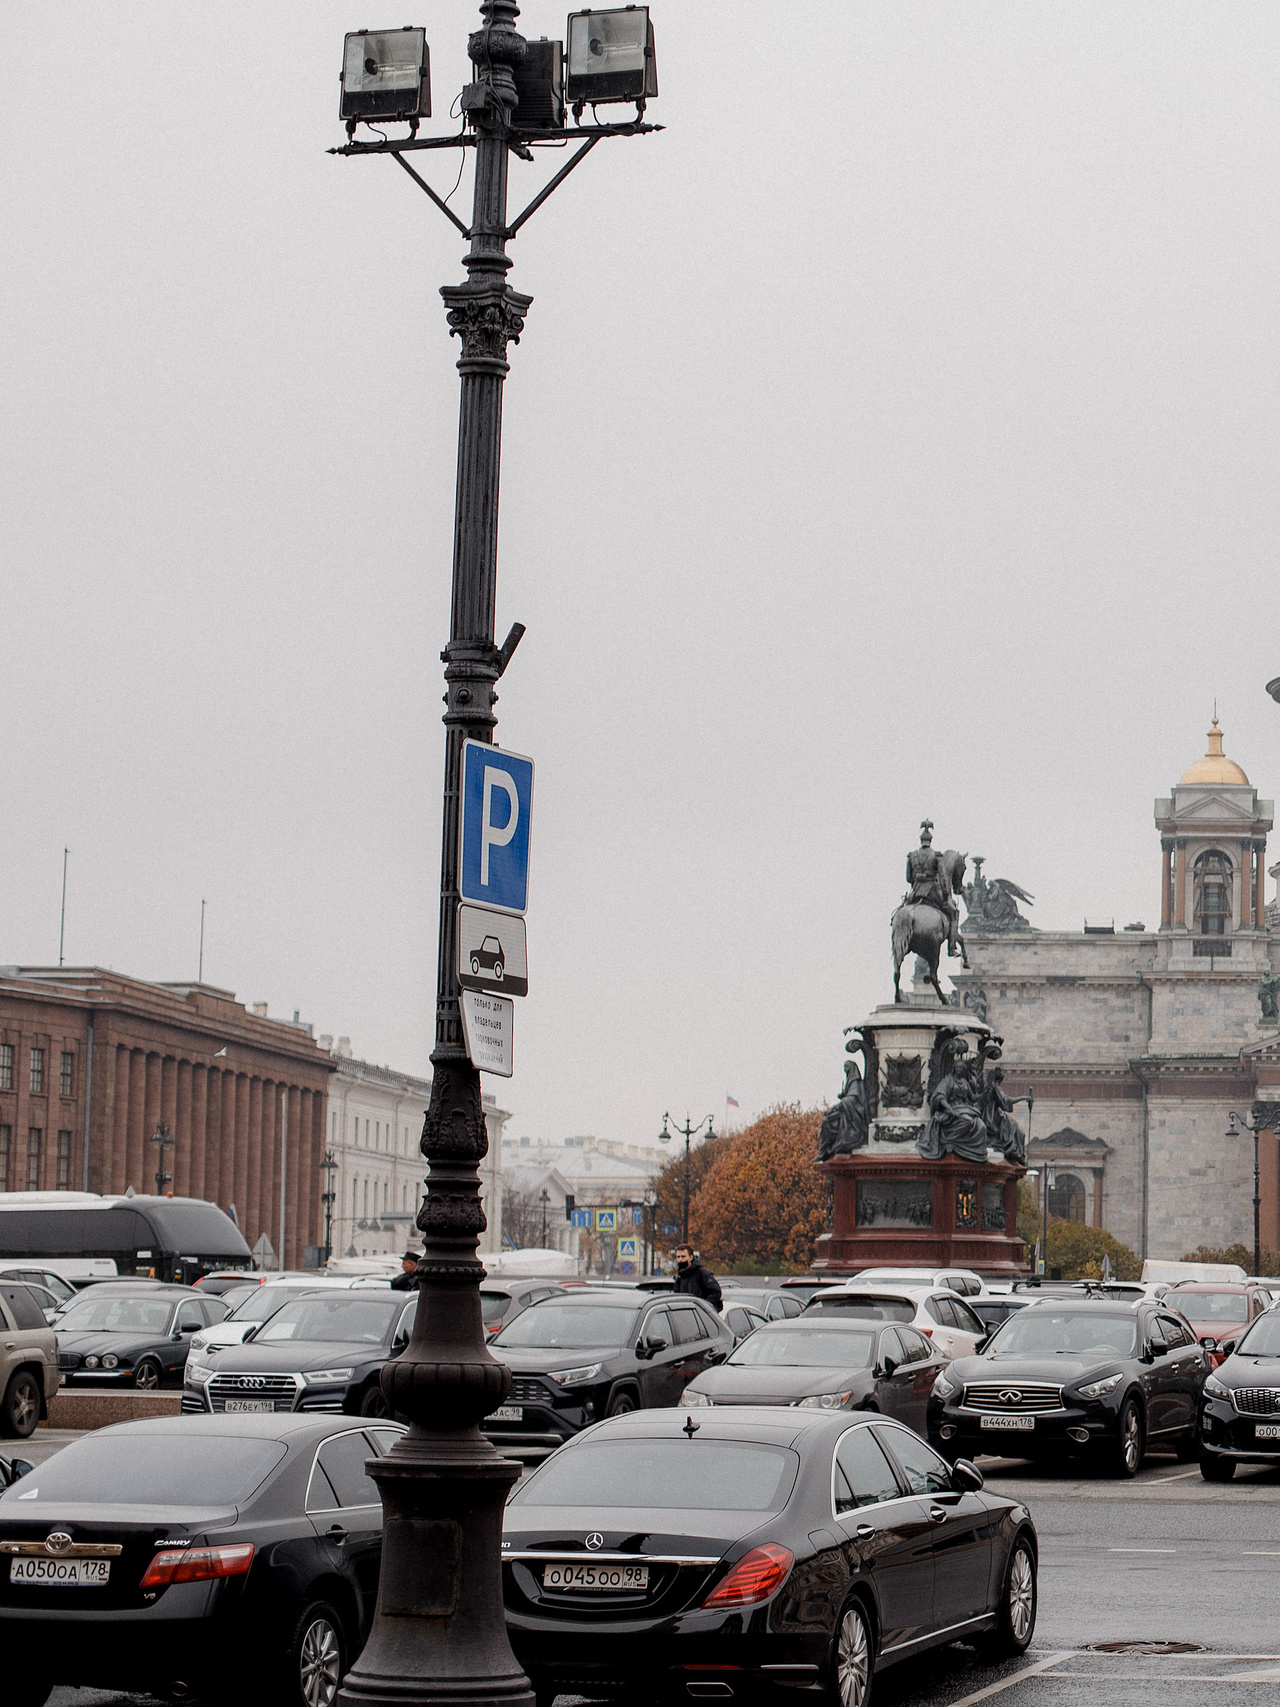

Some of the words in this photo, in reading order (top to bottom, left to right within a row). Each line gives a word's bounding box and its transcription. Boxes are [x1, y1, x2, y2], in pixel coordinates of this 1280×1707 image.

[480, 764, 520, 887] P
[983, 1417, 1018, 1427] В444ХН
[15, 1561, 77, 1580] А050ОА
[82, 1561, 107, 1577] 178
[551, 1567, 621, 1586] О045ОО
[625, 1567, 642, 1582] 98
